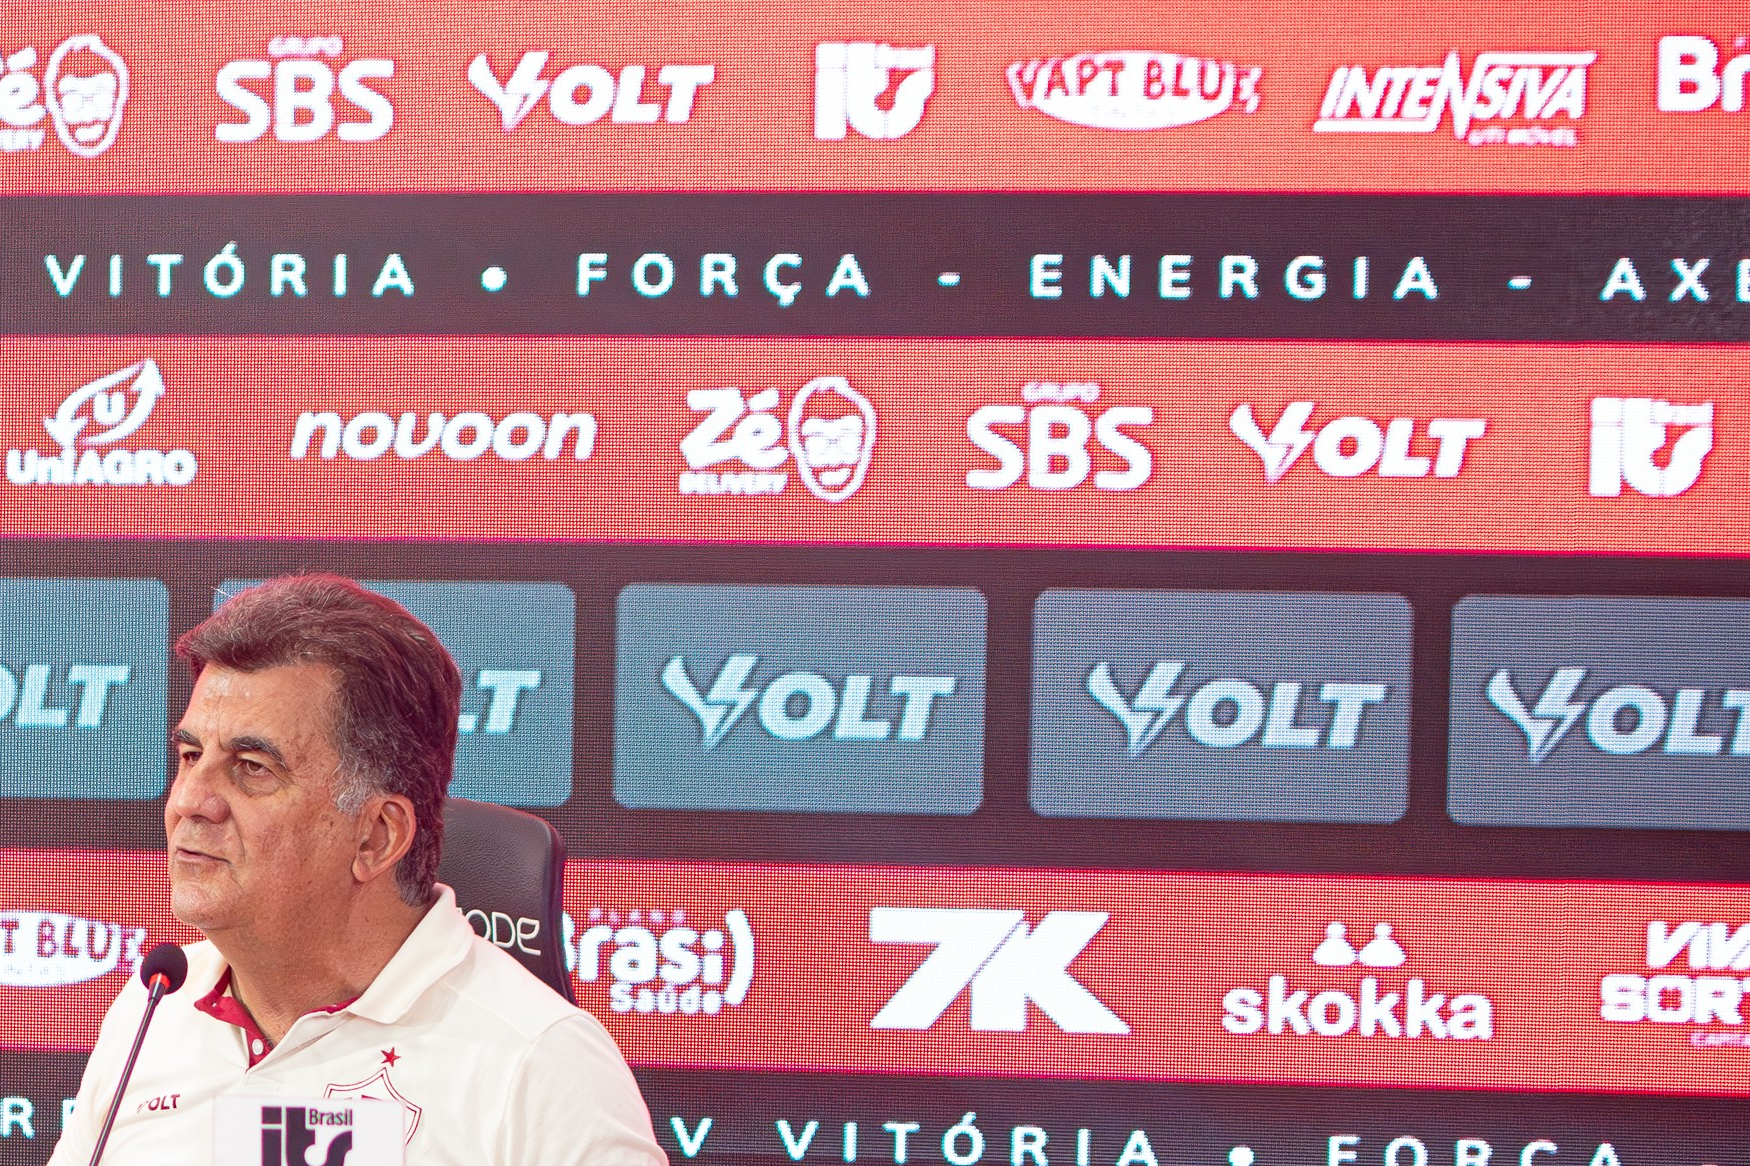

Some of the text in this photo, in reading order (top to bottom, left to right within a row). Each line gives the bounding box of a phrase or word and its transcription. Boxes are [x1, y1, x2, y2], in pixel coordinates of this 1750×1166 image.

[214, 58, 396, 143] SBS
[467, 50, 716, 133] VOLT
[1007, 58, 1125, 108] VAPT
[1315, 48, 1594, 140] INTENSIVA
[44, 240, 415, 298] VITÓRIA
[576, 251, 872, 308] FORÇA
[1029, 253, 1440, 300] ENERGIA
[289, 411, 599, 462] novoon
[678, 387, 790, 470] Zé
[965, 404, 1154, 492] SBS
[1229, 400, 1488, 486] VOLT
[661, 653, 957, 752] VOLT
[1086, 660, 1388, 760] VOLT
[869, 906, 1132, 1035] 7K
[1221, 974, 1493, 1042] skokka
[308, 1107, 354, 1127] Brasil
